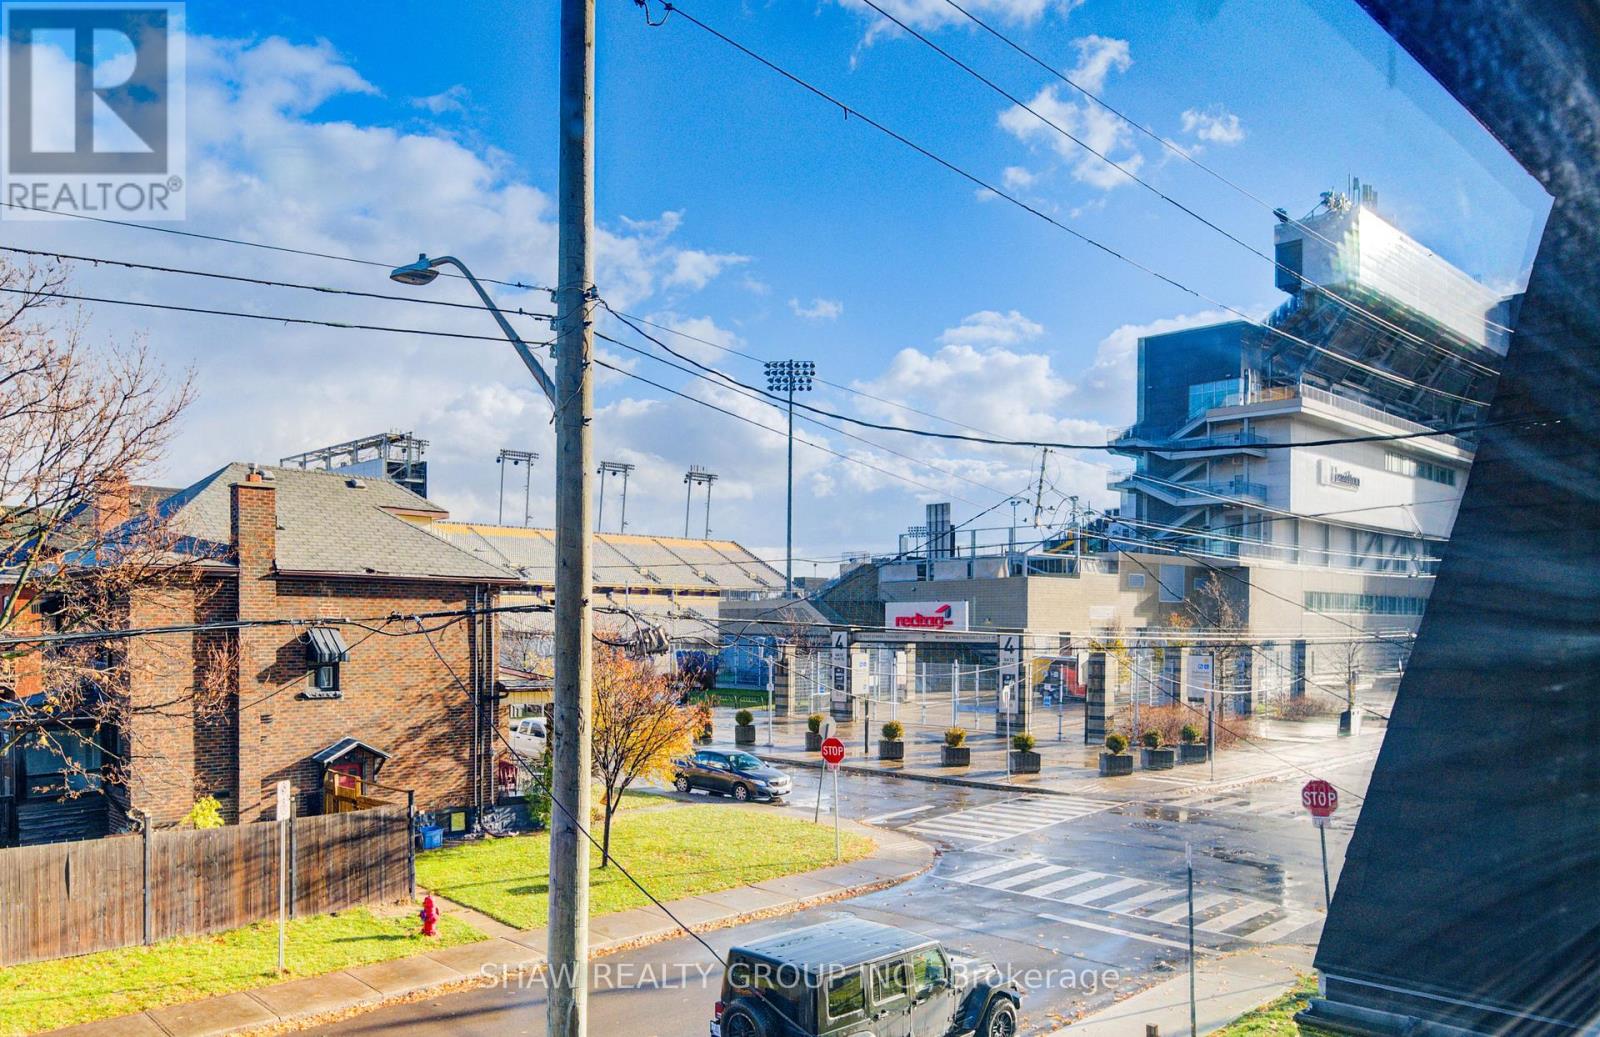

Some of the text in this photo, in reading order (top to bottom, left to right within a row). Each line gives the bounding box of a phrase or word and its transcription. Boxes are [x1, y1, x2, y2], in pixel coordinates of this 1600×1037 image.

[835, 634, 844, 649] 4
[1004, 637, 1015, 654] 4
[822, 745, 844, 756] STOP
[1303, 791, 1336, 806] STOP
